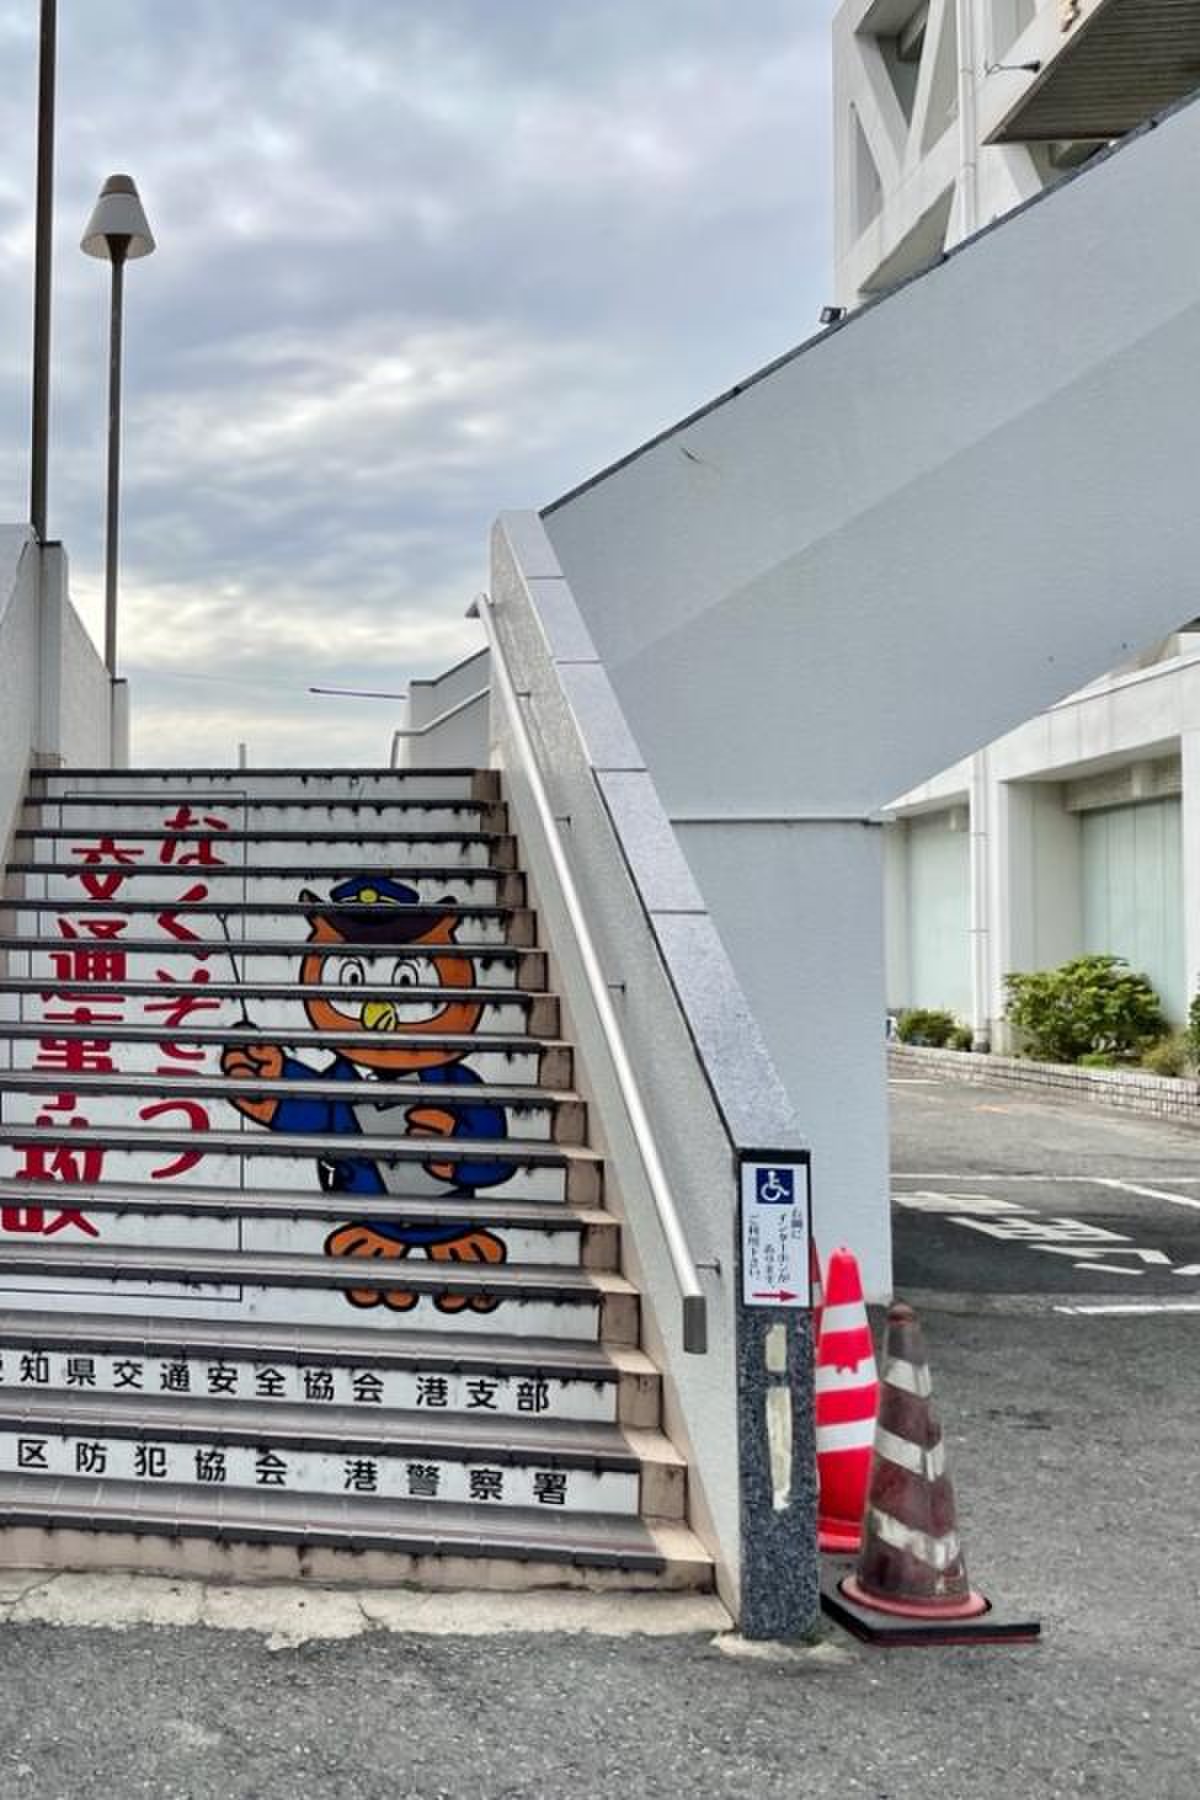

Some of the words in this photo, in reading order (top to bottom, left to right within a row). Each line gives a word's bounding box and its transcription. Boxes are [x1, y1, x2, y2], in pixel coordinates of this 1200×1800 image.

[1, 838, 144, 1237] 交通事故
[139, 805, 229, 1180] なくそう
[343, 1459, 568, 1505] 港警察署
[415, 1376, 550, 1413] 港支部
